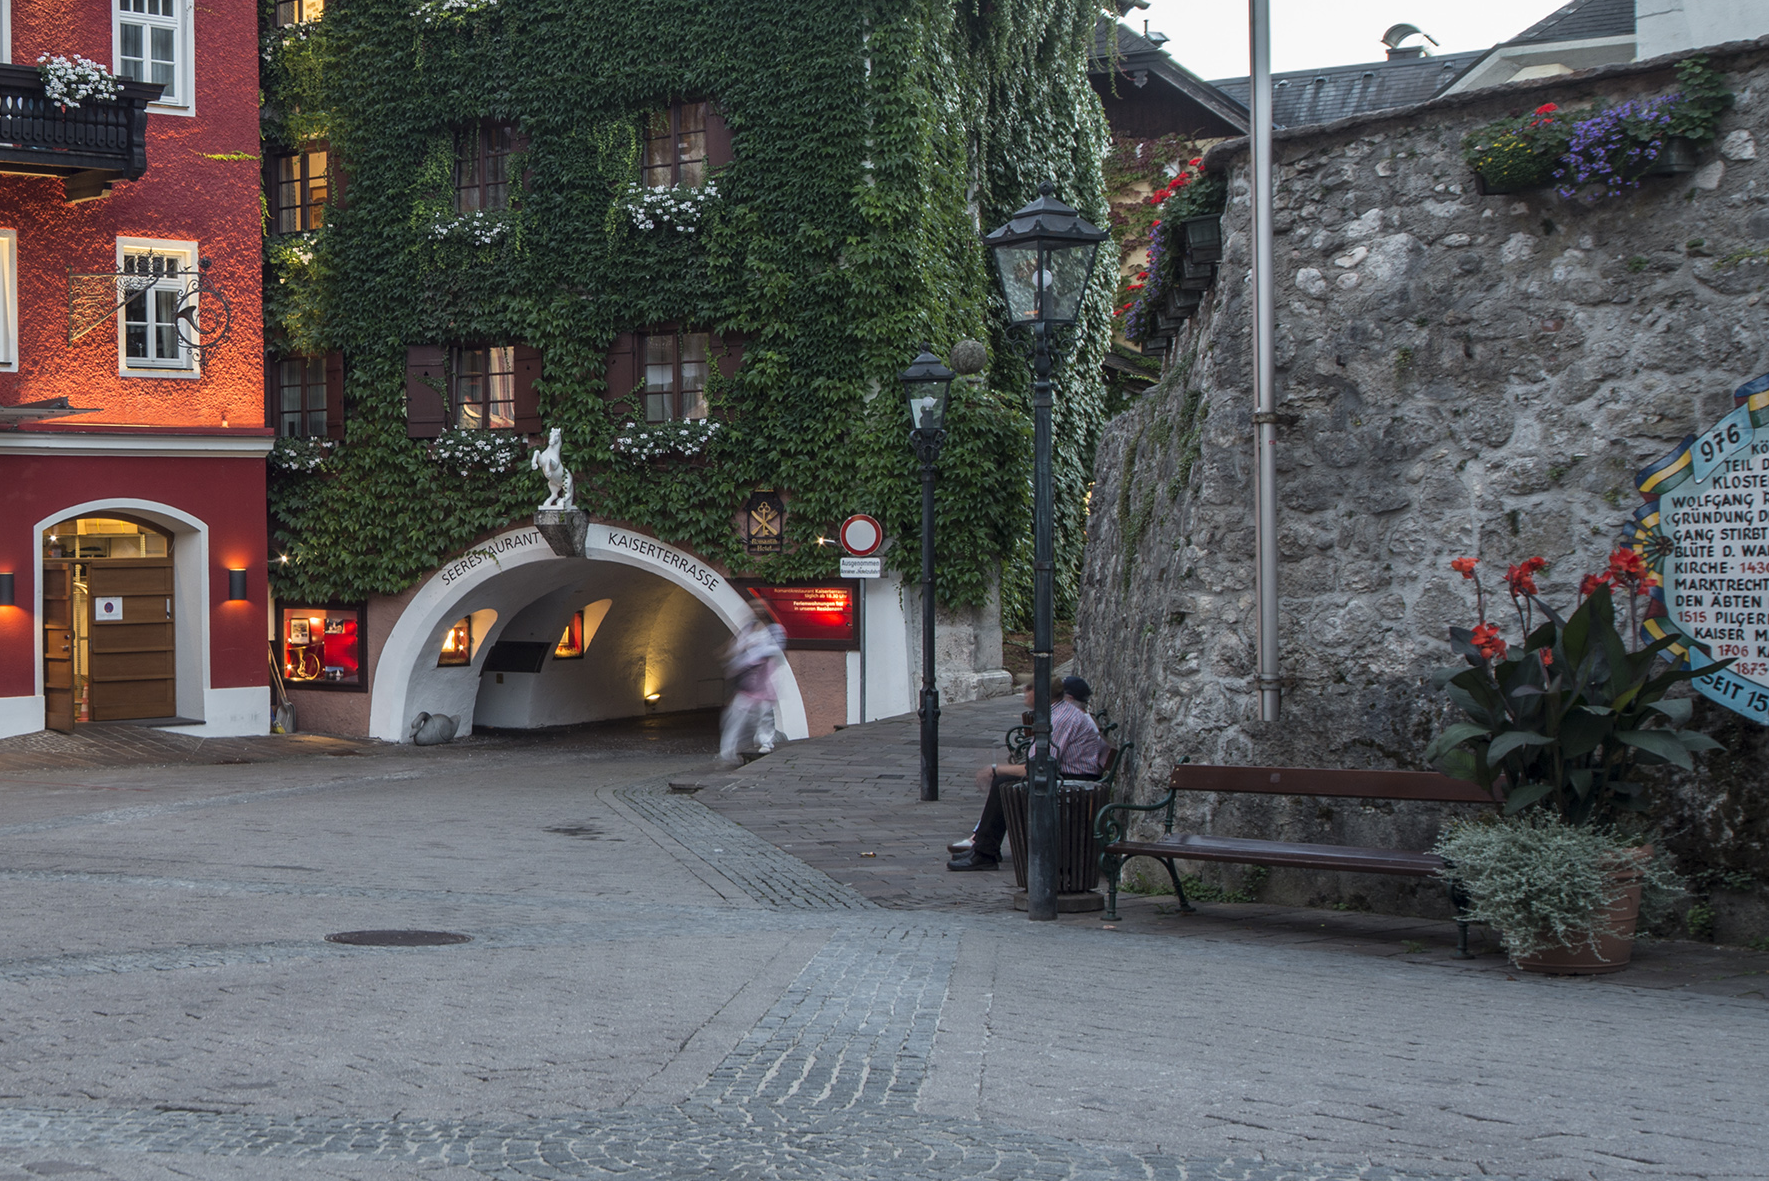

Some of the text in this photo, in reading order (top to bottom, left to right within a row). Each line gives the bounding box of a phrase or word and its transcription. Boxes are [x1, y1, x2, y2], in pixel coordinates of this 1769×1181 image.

[1700, 423, 1741, 462] 976
[1724, 459, 1753, 473] TEIL
[1671, 493, 1754, 510] WOLFGANG
[1671, 508, 1754, 526] GRÜNDUNG
[1673, 527, 1769, 544] GANG STIRBT
[1674, 542, 1715, 558] BLÜTE
[1723, 545, 1736, 557] D.
[441, 531, 719, 592] SEERESTAURANT KAISERTERRASSE
[841, 560, 880, 568] Ausgenommen
[1675, 592, 1762, 608] DEN ÄBTEN
[1677, 611, 1769, 627] 1515 PILGER
[1694, 628, 1745, 641] KAISER
[1717, 645, 1749, 657] 1706
[1699, 671, 1745, 700] SEIT
